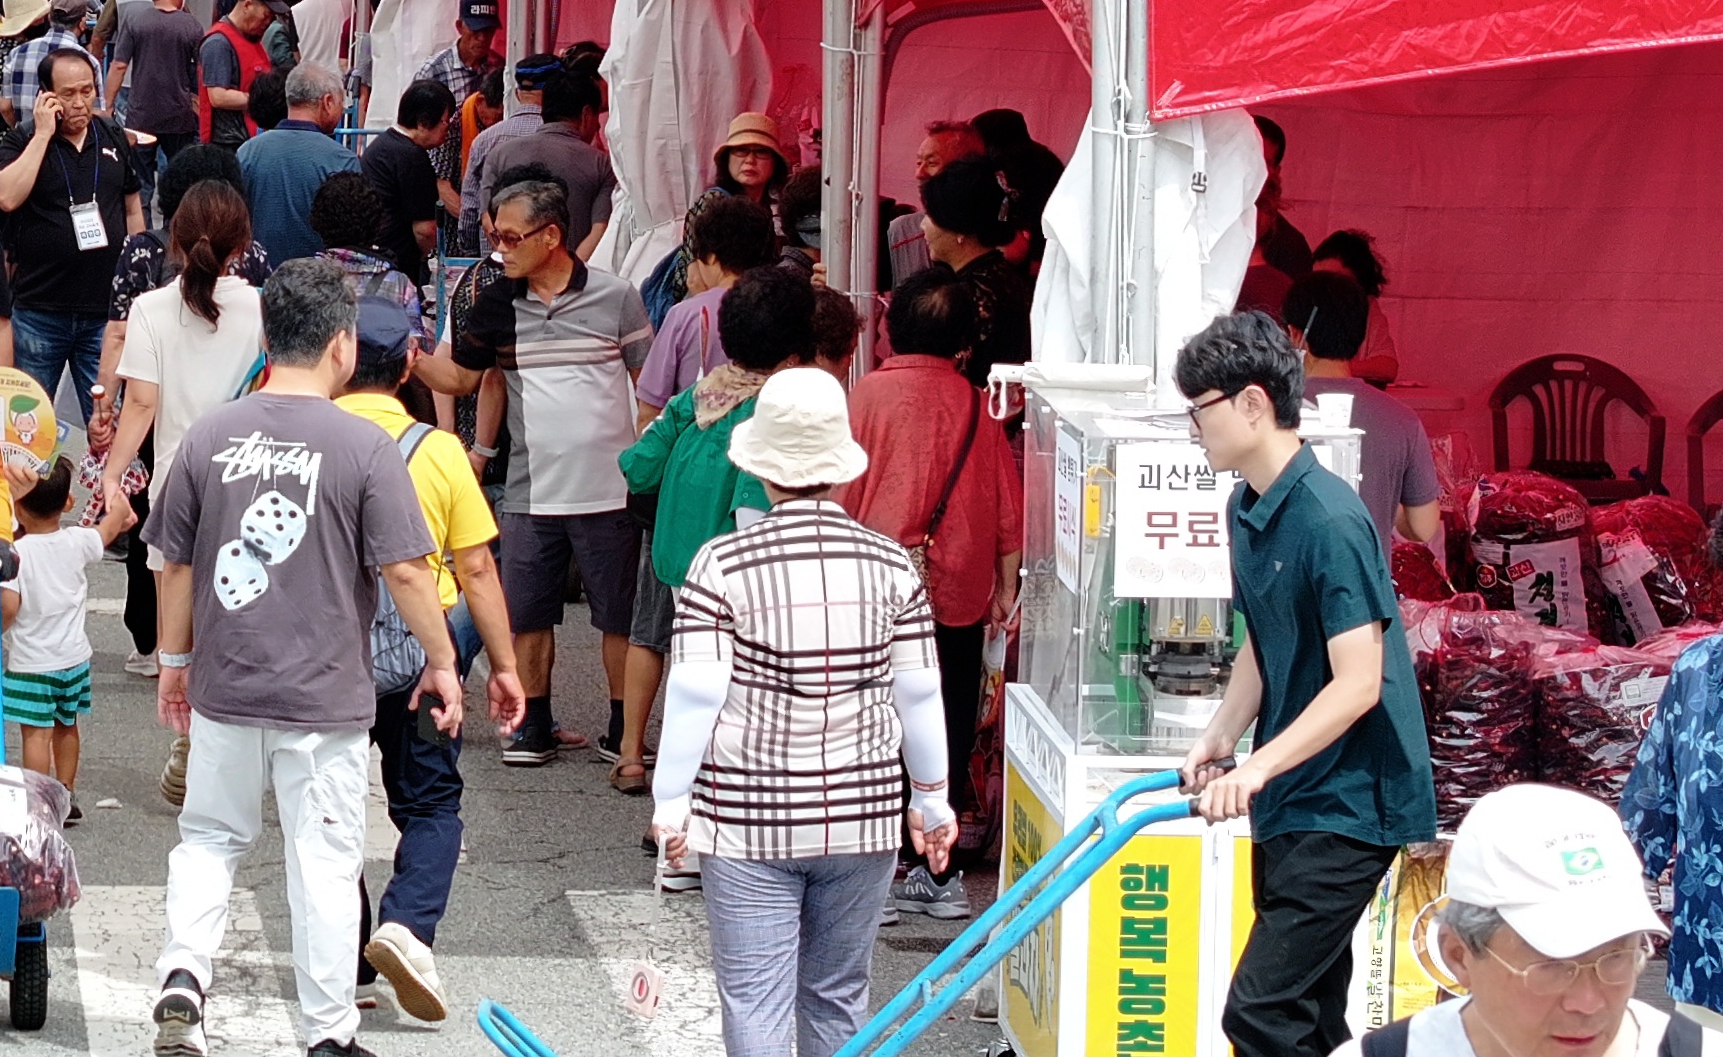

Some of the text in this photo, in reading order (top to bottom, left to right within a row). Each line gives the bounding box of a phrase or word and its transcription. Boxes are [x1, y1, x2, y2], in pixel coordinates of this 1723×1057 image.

[1137, 463, 1218, 491] 괴산쌀
[1144, 510, 1231, 551] 무료
[1528, 570, 1559, 627] 청결
